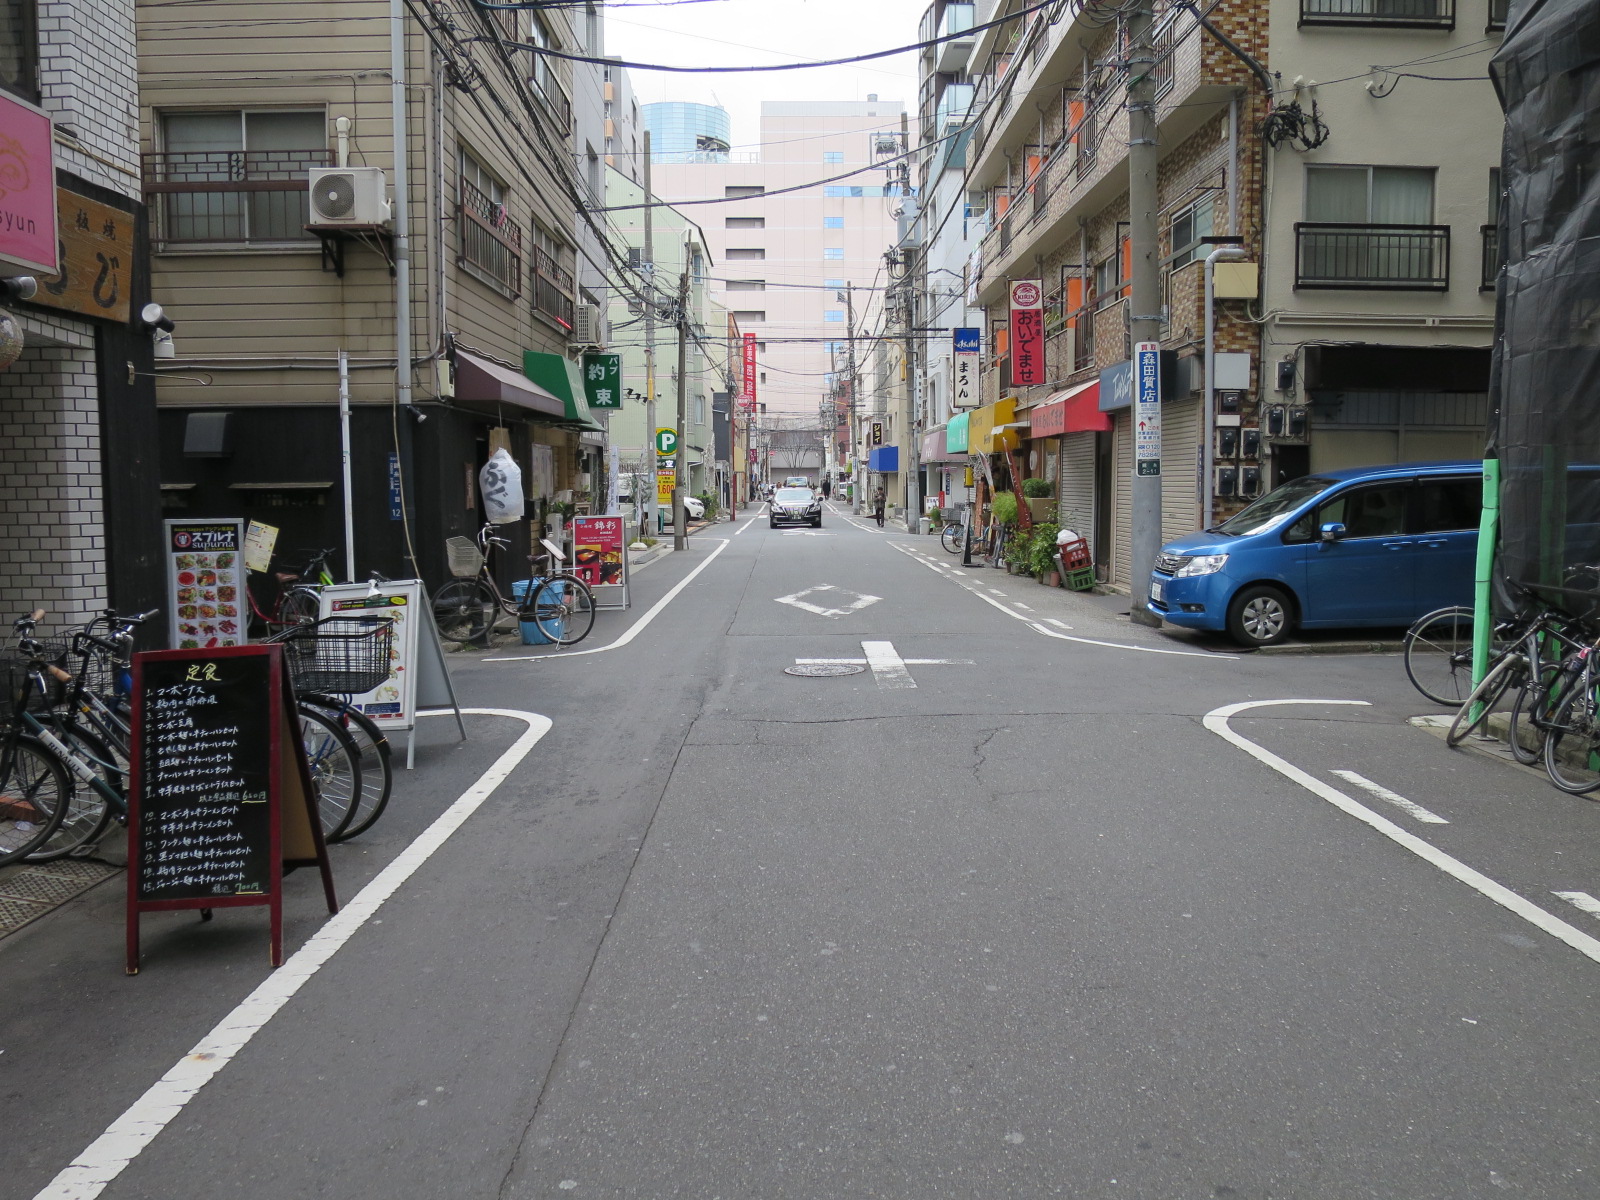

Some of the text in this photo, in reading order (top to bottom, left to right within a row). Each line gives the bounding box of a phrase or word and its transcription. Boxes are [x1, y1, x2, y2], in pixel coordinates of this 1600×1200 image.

[954, 339, 978, 349] Asahi
[1017, 310, 1035, 382] おいでませ
[609, 357, 618, 376] パブ
[588, 363, 613, 406] 約束
[958, 361, 969, 398] まろん
[1142, 352, 1157, 402] 森田質店
[662, 433, 675, 450] P
[392, 509, 400, 517] 12
[192, 530, 235, 542] スプルナ
[192, 541, 234, 550] supurna
[186, 662, 222, 681] 定食
[48, 742, 80, 772] RENAULT
